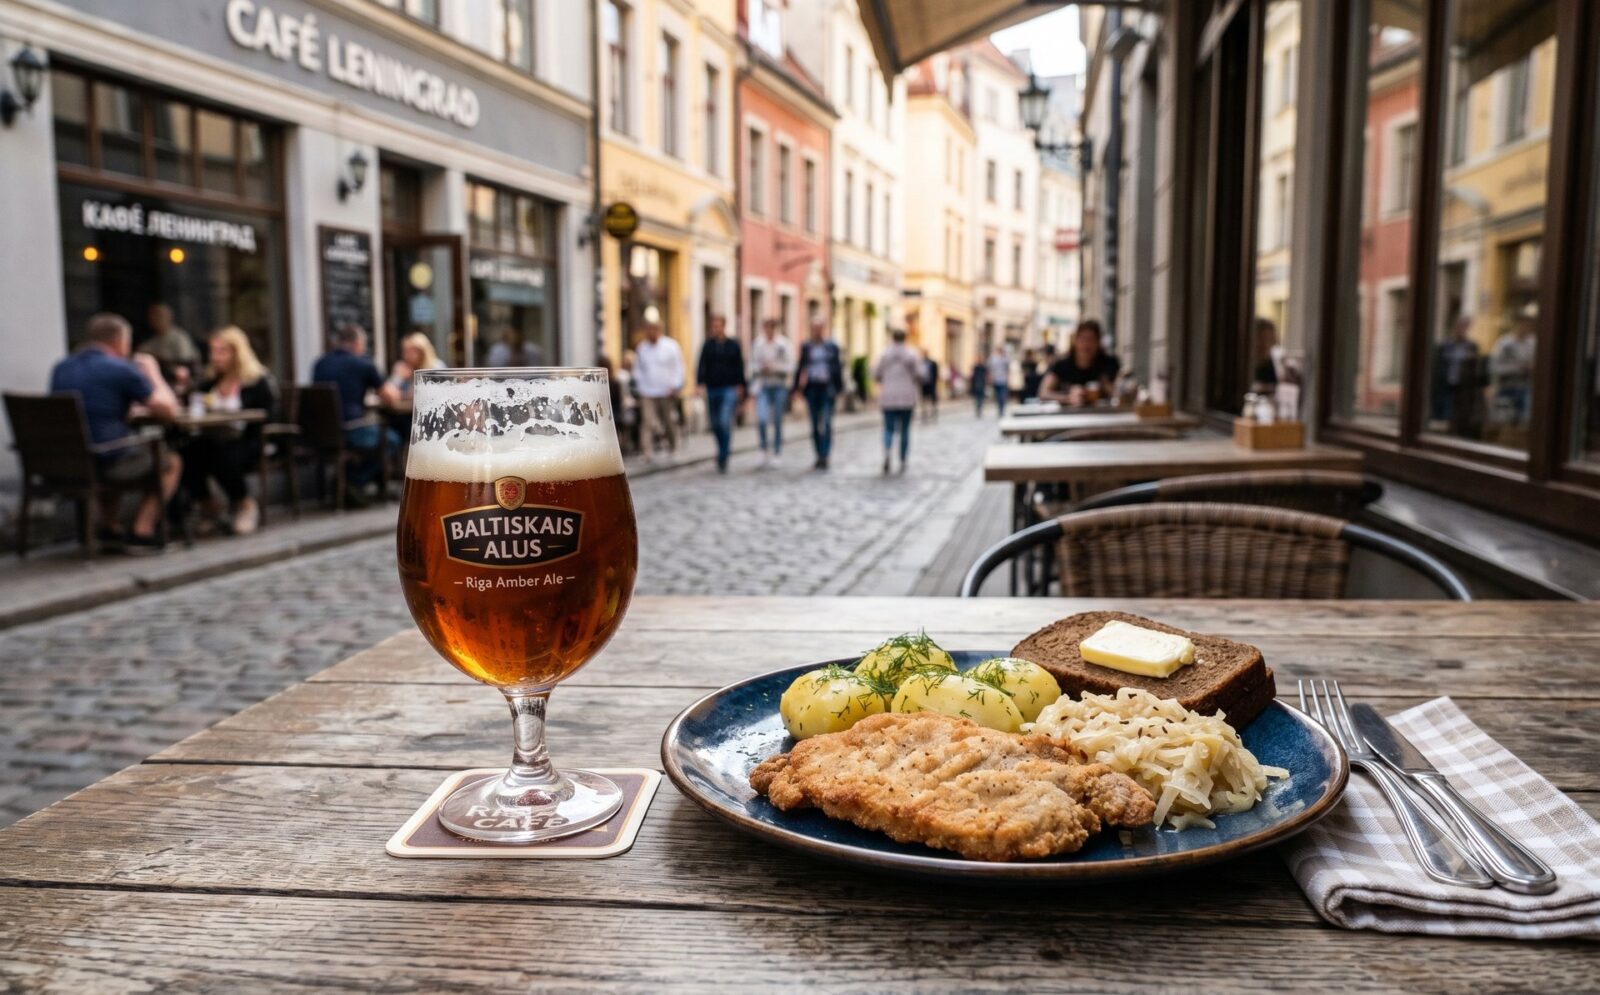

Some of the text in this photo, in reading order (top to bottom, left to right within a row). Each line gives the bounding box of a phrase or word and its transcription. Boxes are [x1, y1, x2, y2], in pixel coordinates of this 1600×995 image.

[226, 0, 480, 129] CAFÉ LENINGRAD
[147, 210, 257, 253] ЛЕНИНГРАД
[451, 516, 574, 540] BALTISKAIS
[484, 539, 542, 559] ALUS
[466, 573, 564, 592] Riga Amber Ale
